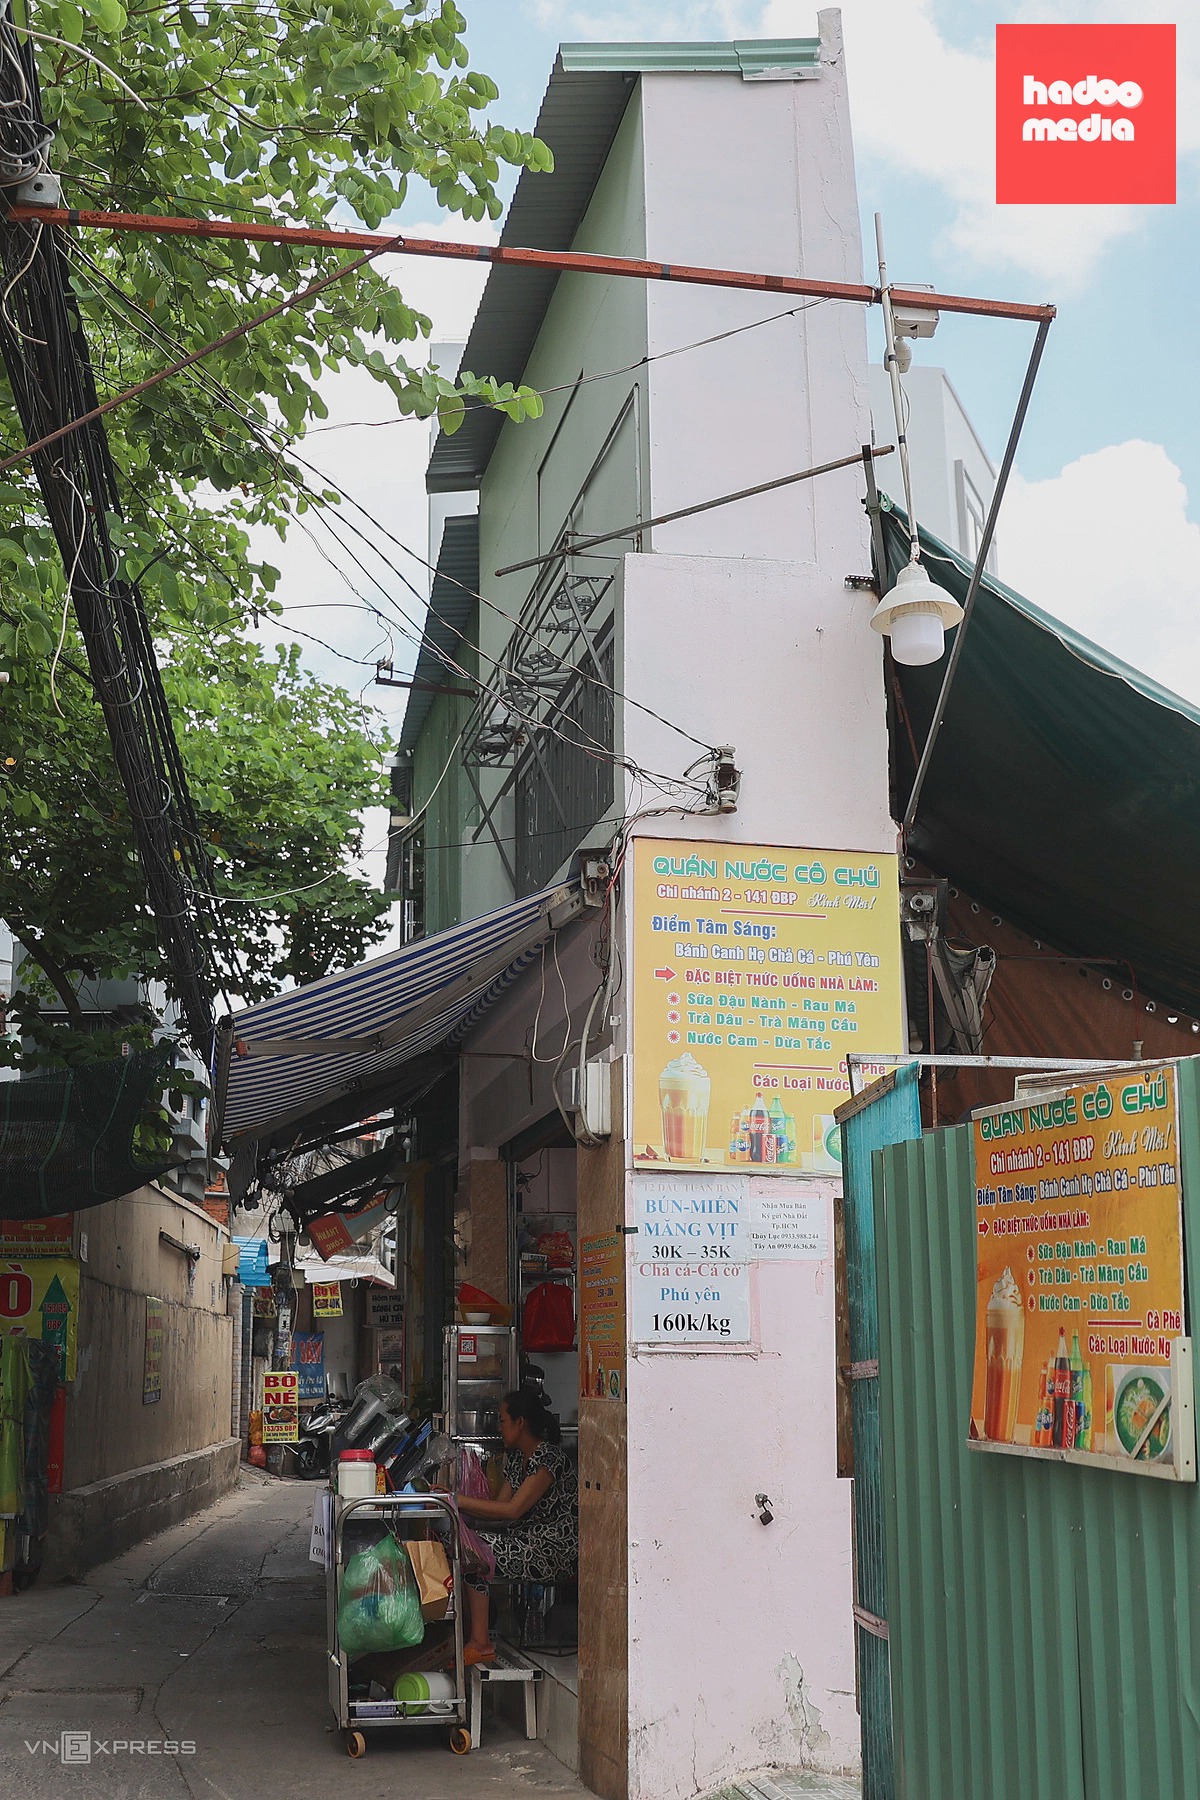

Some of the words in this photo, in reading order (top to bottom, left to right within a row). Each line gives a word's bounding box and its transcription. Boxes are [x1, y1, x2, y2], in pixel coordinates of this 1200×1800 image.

[653, 854, 717, 877] QUÁN
[724, 858, 787, 882] NƯỚC
[794, 861, 826, 885] CÔ
[834, 865, 880, 887] CHÚ
[657, 884, 678, 898] Chi
[681, 886, 720, 901] nhánh
[722, 888, 732, 901] 2
[745, 889, 767, 904] 141
[771, 891, 797, 905] ĐBP
[652, 914, 691, 932] Điểm
[696, 918, 728, 934] Tâm
[733, 920, 777, 940] Sáng:
[675, 942, 708, 958] Bánh
[711, 944, 744, 960] Canh
[748, 947, 765, 964] Hẹ
[768, 948, 793, 963] Chả
[797, 949, 814, 964] Cá
[828, 951, 852, 966] Phú
[855, 952, 879, 967] Yên
[685, 969, 711, 985] ĐẶC
[715, 970, 742, 986] BIỆT
[745, 972, 778, 987] THỨC
[783, 972, 816, 988] UỐNG
[820, 976, 844, 990] NHÀ
[849, 977, 878, 992] LÀM:
[687, 992, 713, 1006] Sữa
[718, 994, 746, 1009] Đậu
[751, 996, 786, 1009] Nành
[803, 999, 829, 1012] Rau
[834, 1001, 856, 1013] Má
[687, 1011, 711, 1024] Trà
[716, 1013, 743, 1026] Dâu
[759, 1015, 782, 1028] Trà
[687, 1031, 723, 1045] Nước
[727, 1033, 758, 1047] Cam
[775, 1036, 801, 1049] Dừa
[806, 1037, 831, 1050] Tắc
[753, 1075, 778, 1089] Các
[783, 1076, 812, 1091] Loại
[816, 1077, 850, 1090] Nước
[1082, 1083, 1113, 1120] CÔ
[1121, 1072, 1168, 1114] CHÚ
[990, 1150, 1006, 1175] Chi
[1006, 1145, 1035, 1172] nhánh
[1036, 1144, 1044, 1168] 2
[1052, 1139, 1070, 1164] 141
[1072, 1134, 1095, 1163] ĐBP
[977, 1185, 996, 1206] Điểm
[998, 1185, 1014, 1203] Tâm
[1015, 1183, 1037, 1203] Sáng:
[1039, 1178, 1059, 1199] Bánh
[1060, 1175, 1080, 1197] Canh
[1081, 1173, 1093, 1197] Hẹ
[1094, 1168, 1112, 1192] Chả
[1114, 1167, 1128, 1191] Cá
[1138, 1164, 1157, 1188] Phú
[1159, 1162, 1176, 1185] Yên
[644, 1219, 701, 1237] MĂNG
[706, 1222, 739, 1240] VỊT
[993, 1217, 1006, 1238] ĐẶC
[1007, 1214, 1021, 1236] BIỆT
[1021, 1213, 1039, 1233] THỨC
[1040, 1210, 1057, 1230] UỐNG
[1058, 1209, 1072, 1230] NHÀ
[1072, 1208, 1090, 1228] LÀM:
[652, 1245, 683, 1258] 30K
[700, 1245, 731, 1258] 35K
[1038, 1243, 1054, 1260] Sữa
[1055, 1241, 1072, 1262] Đậu
[1074, 1240, 1097, 1258] Nành
[1106, 1238, 1126, 1257] Rau
[1129, 1236, 1147, 1255] Má
[640, 1263, 670, 1277] Chả
[1039, 1267, 1053, 1284] Trà
[1055, 1266, 1071, 1284] Dâu
[1079, 1264, 1095, 1283] Trà
[660, 1287, 689, 1301] Phú
[695, 1287, 720, 1304] yên
[1062, 1294, 1081, 1311] Cam
[1090, 1292, 1109, 1312] Dừa
[652, 1313, 731, 1336] 160k/kg
[1146, 1310, 1160, 1330] Cà
[1162, 1310, 1182, 1331] Phê
[1088, 1334, 1106, 1354] Các
[1107, 1335, 1129, 1359] Loại
[1131, 1335, 1156, 1356] Nước
[1158, 1336, 1171, 1360] Ng
[264, 1373, 297, 1388] BÒ
[264, 1390, 297, 1405] NÉ
